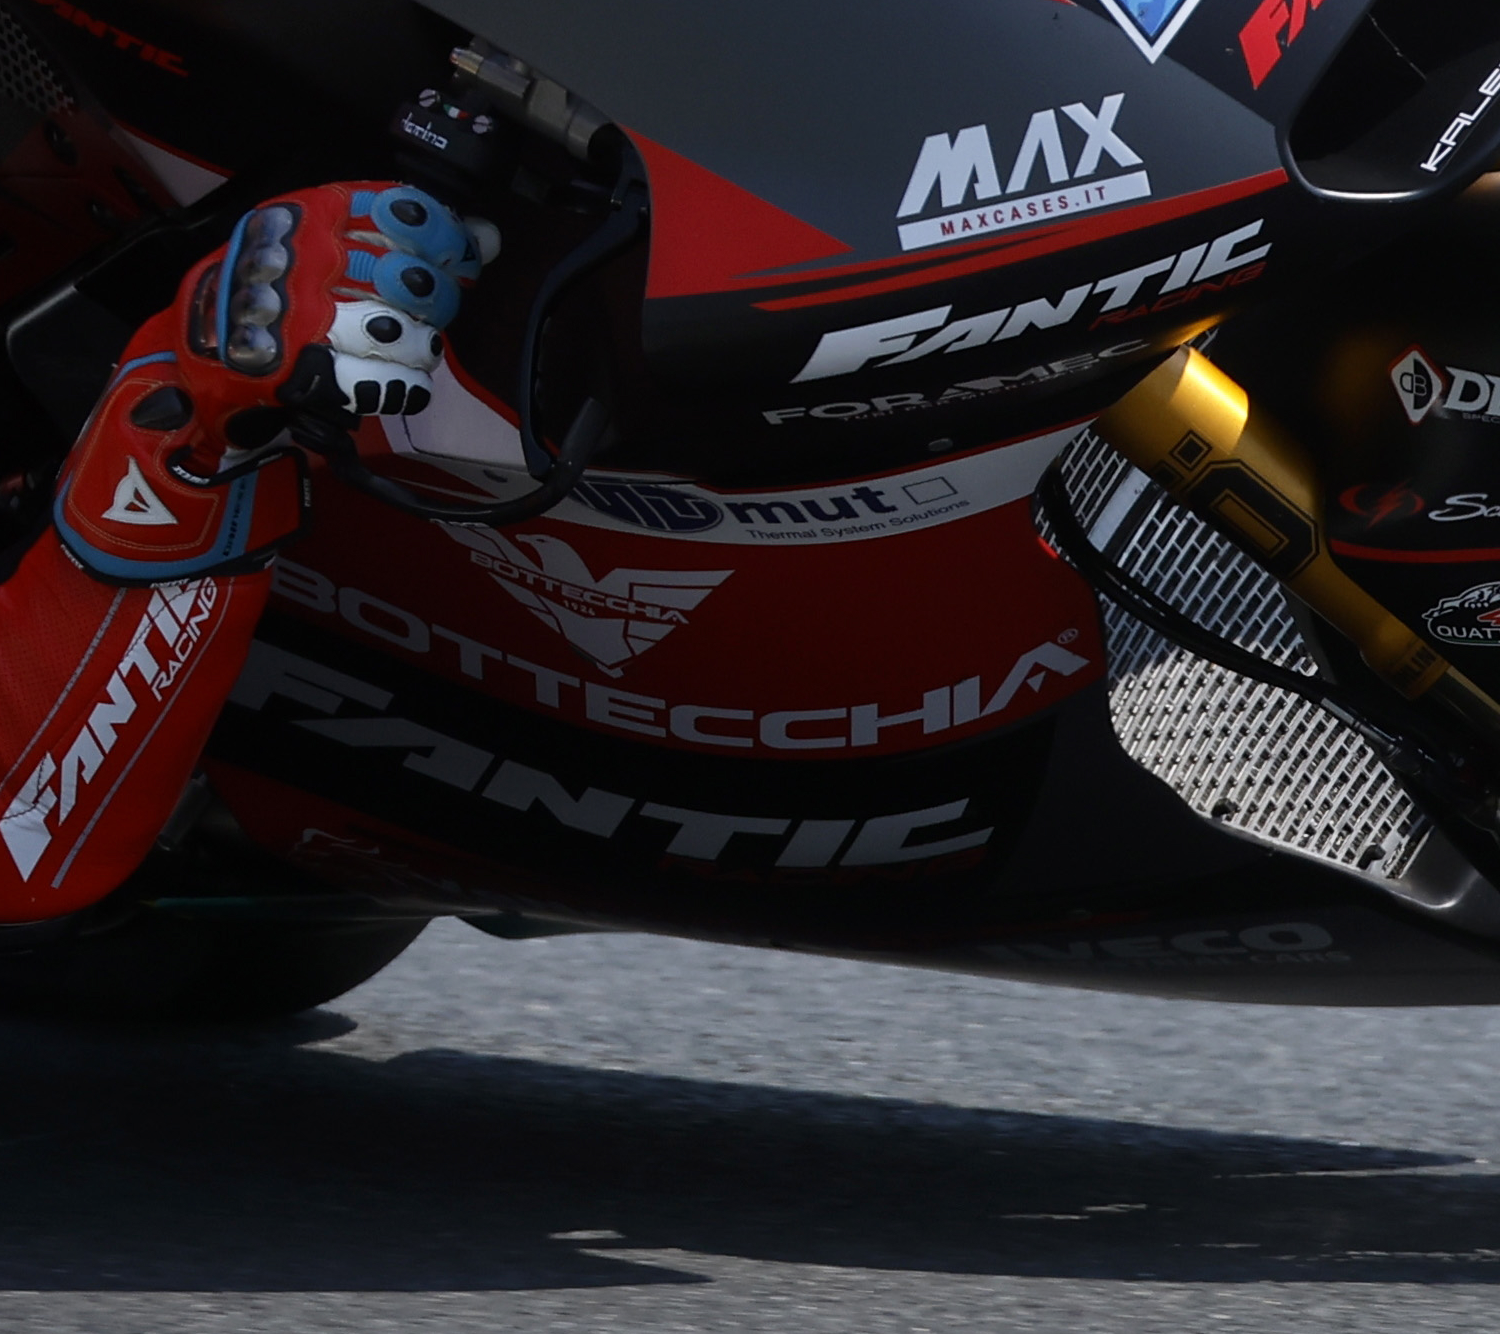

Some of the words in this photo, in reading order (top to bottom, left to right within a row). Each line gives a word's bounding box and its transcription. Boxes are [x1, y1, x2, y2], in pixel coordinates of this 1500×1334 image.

[895, 92, 1144, 218] MAX
[940, 185, 1107, 237] MAXCASES.IT
[788, 217, 1274, 384] FANTIC
[1089, 260, 1267, 331] RACING
[760, 338, 1150, 427] FORAMEC
[725, 486, 898, 525] mut
[745, 528, 817, 541] Thermal
[820, 522, 886, 540] System
[889, 497, 971, 529] Solutions
[468, 551, 690, 625] BOTTECCHIA
[150, 575, 218, 702] RACING
[268, 554, 1091, 750] BOTTECCHIA
[227, 636, 996, 868] FANTIC
